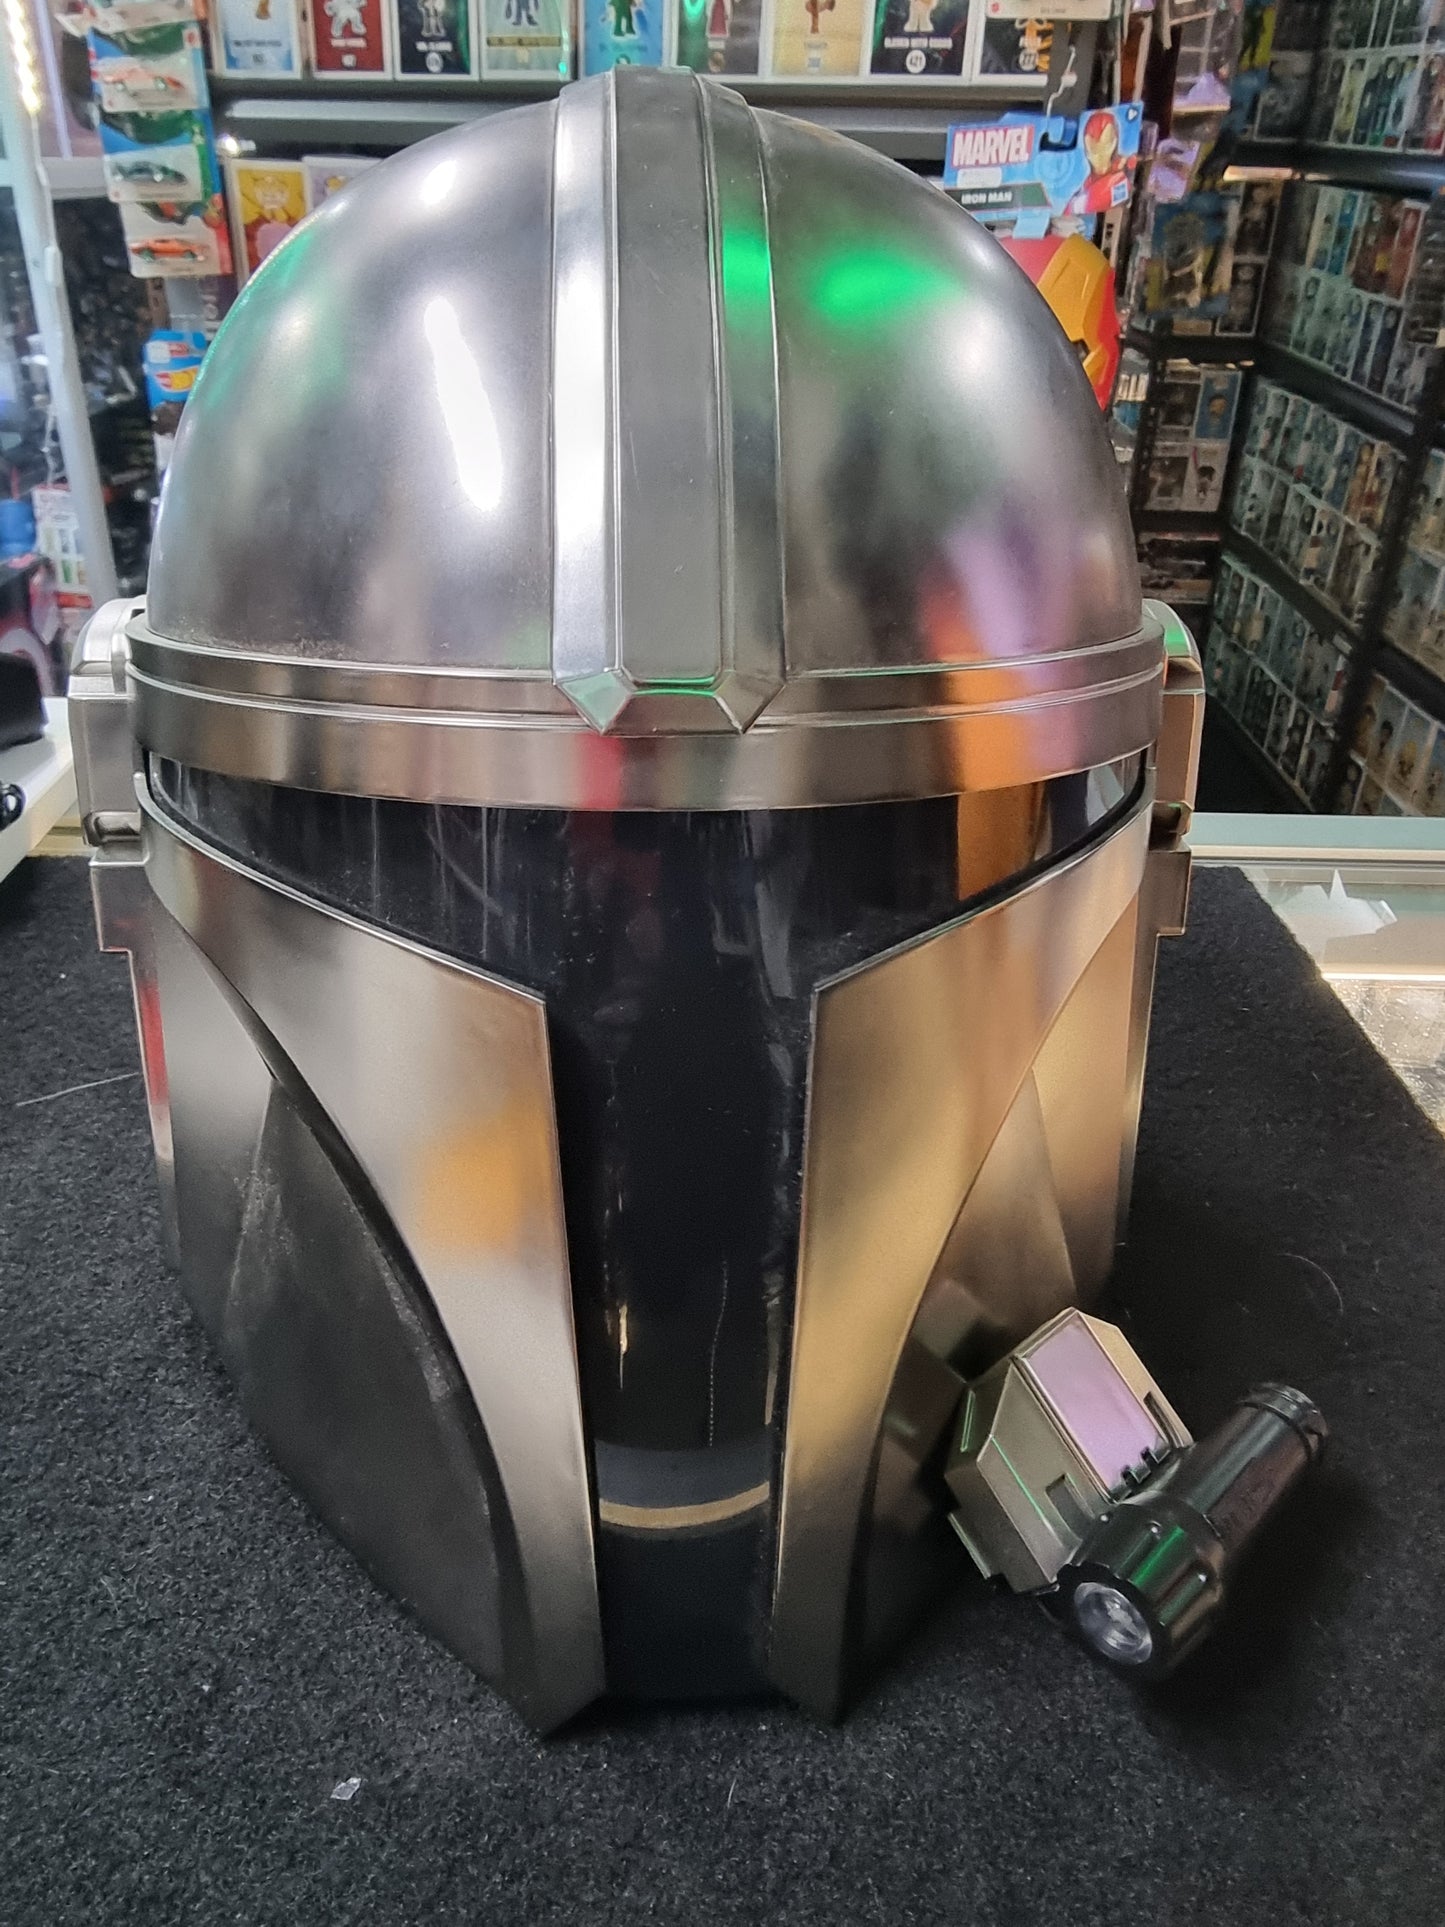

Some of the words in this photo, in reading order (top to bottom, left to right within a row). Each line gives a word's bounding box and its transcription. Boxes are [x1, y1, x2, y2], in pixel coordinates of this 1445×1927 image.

[952, 126, 1029, 167] MARVEL
[961, 193, 987, 205] IRON
[988, 191, 1013, 203] MAN
